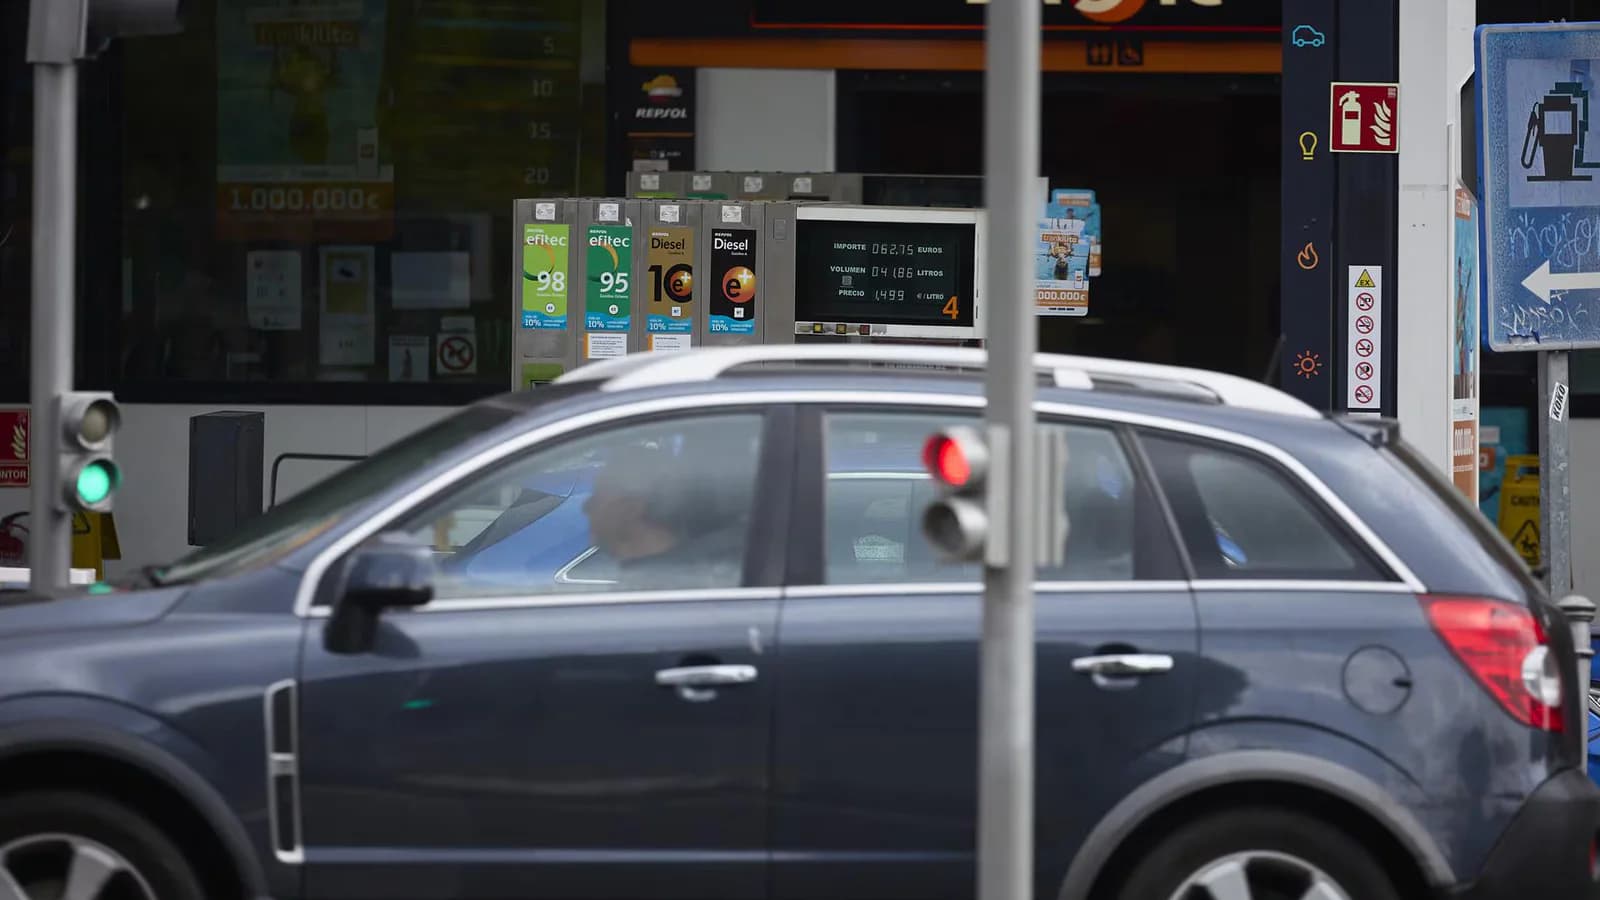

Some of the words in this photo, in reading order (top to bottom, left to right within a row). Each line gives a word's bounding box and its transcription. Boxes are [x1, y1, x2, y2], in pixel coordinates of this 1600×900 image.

[635, 107, 687, 119] REPSOL
[527, 233, 567, 247] efitec
[589, 234, 630, 248] efitec
[651, 238, 686, 250] Diesel
[714, 238, 748, 251] Diesel
[833, 243, 866, 251] IMPORTE
[917, 246, 943, 254] EUROS
[830, 265, 866, 274] VOLUMEN
[917, 269, 944, 277] LITROS
[536, 271, 565, 292] 98
[600, 271, 630, 293] 95
[838, 289, 865, 297] PRECIO
[1036, 290, 1086, 301] 000.000€
[942, 296, 960, 320] 4
[524, 318, 542, 327] 10%
[587, 320, 605, 329] 10%
[649, 322, 667, 331] 10%
[711, 323, 729, 332] 10%
[1552, 384, 1566, 419] KOKO
